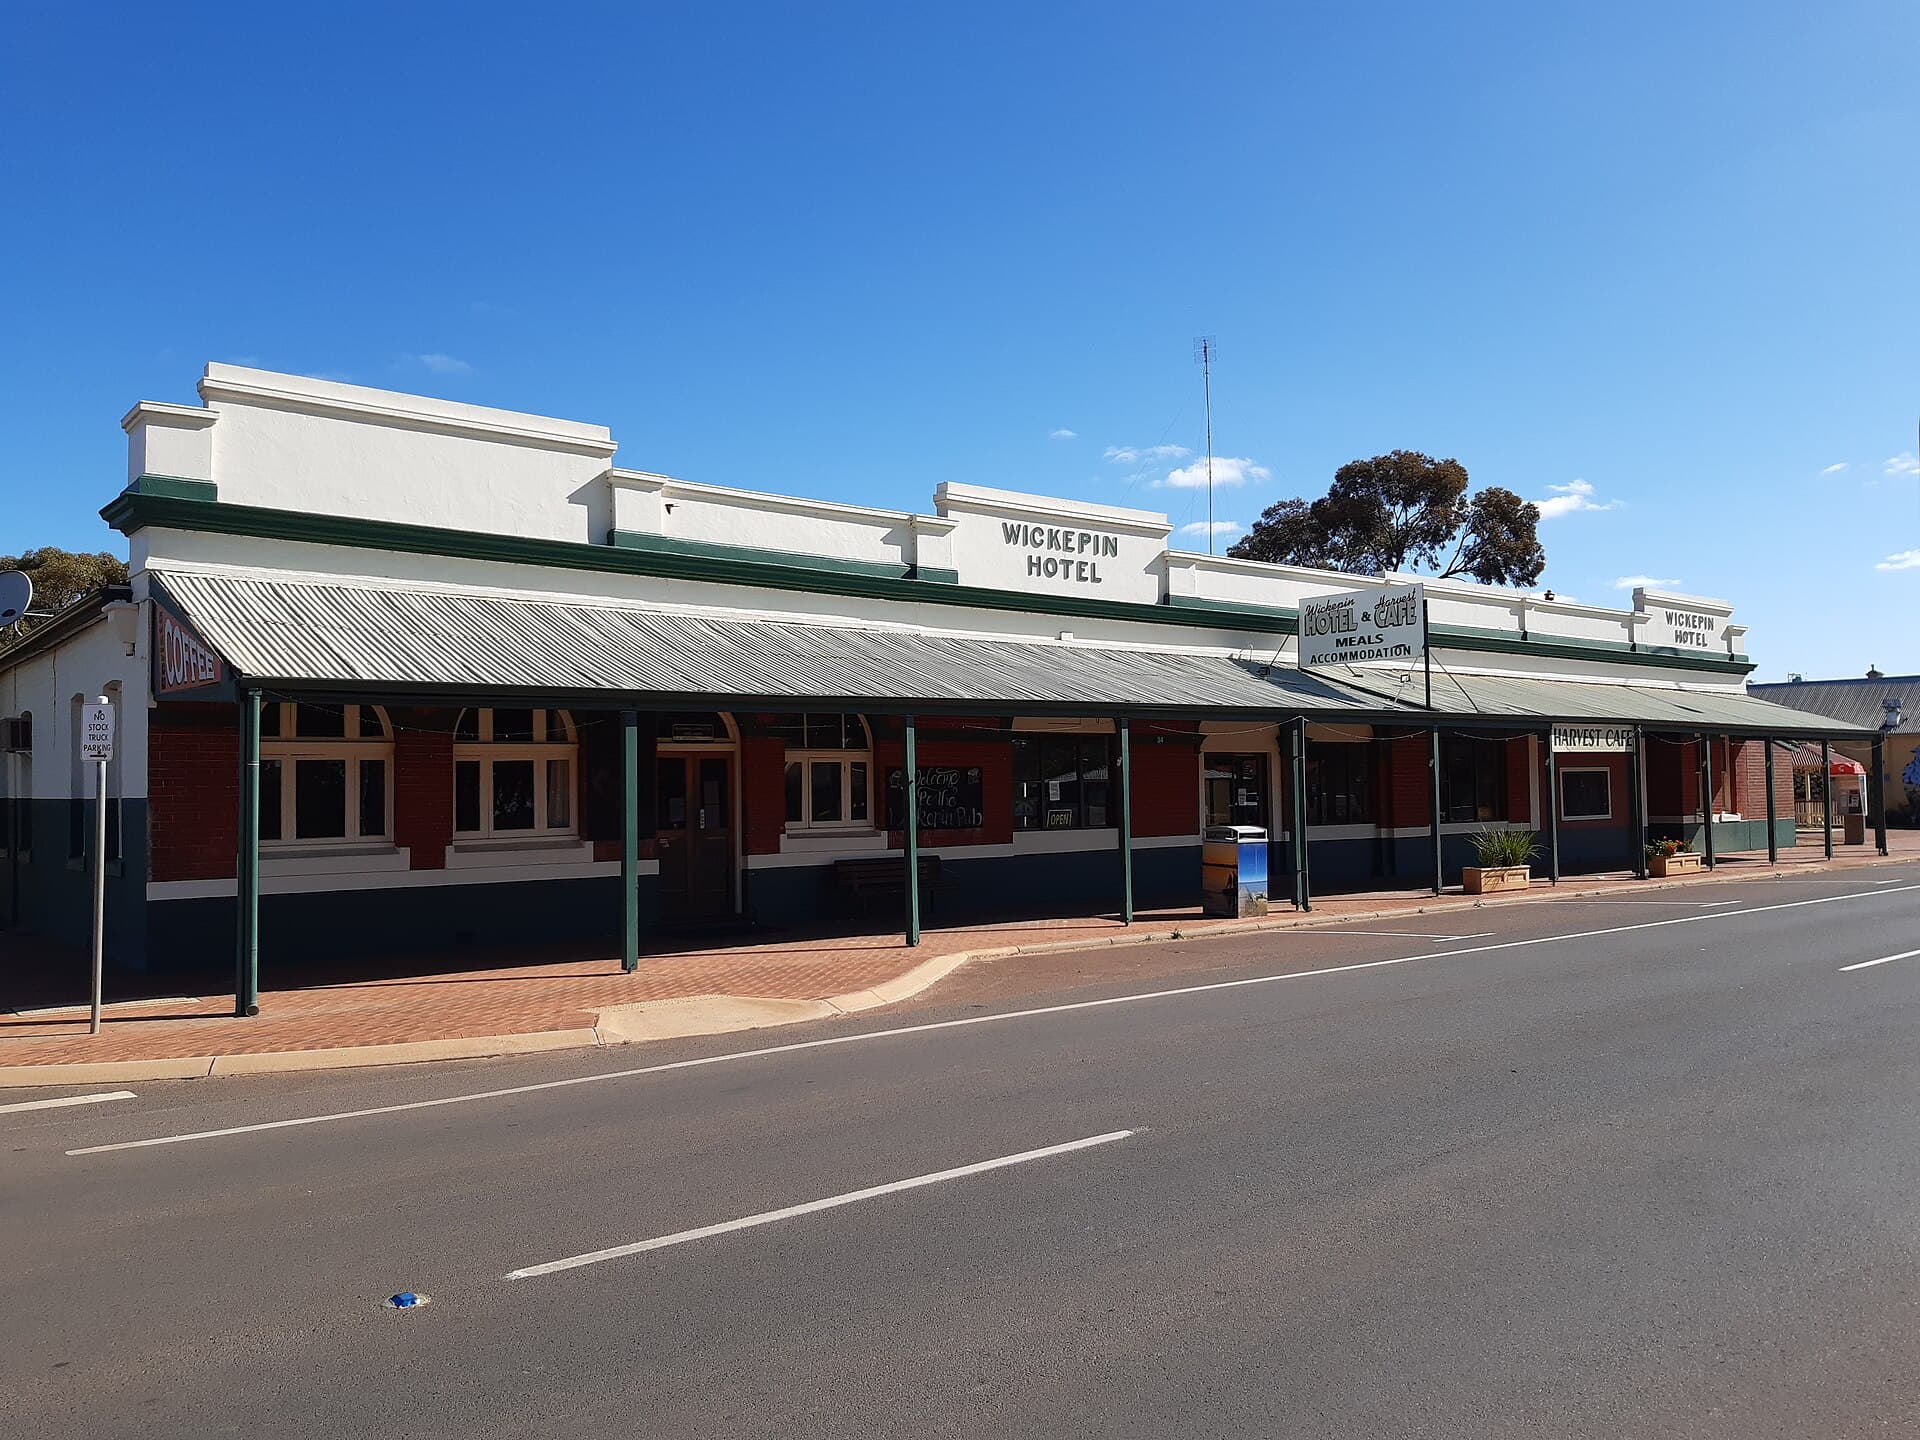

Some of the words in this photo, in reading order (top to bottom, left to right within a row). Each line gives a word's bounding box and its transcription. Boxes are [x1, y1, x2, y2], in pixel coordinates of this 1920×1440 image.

[1001, 522, 1118, 558] WICKEPIN
[1026, 555, 1102, 584] HOTEL
[1305, 598, 1356, 617] Wickepin
[1374, 587, 1416, 610] Harvest
[1304, 607, 1359, 637] HOTEL
[1361, 611, 1372, 622] &
[1374, 600, 1417, 629] CAFE
[1665, 610, 1714, 631] WICKEPIN
[1335, 633, 1384, 648] MEALS
[1674, 629, 1708, 648] HOTEL
[165, 618, 215, 687] COFFEE
[1310, 645, 1411, 665] ACCOMMODATION
[88, 723, 109, 731] STOCK
[94, 713, 105, 721] NO
[88, 733, 109, 741] TRUCK
[1553, 727, 1602, 747] HARVEST
[1605, 729, 1633, 747] CAFE
[83, 744, 112, 752] PARKING
[1050, 812, 1069, 825] OPEN
